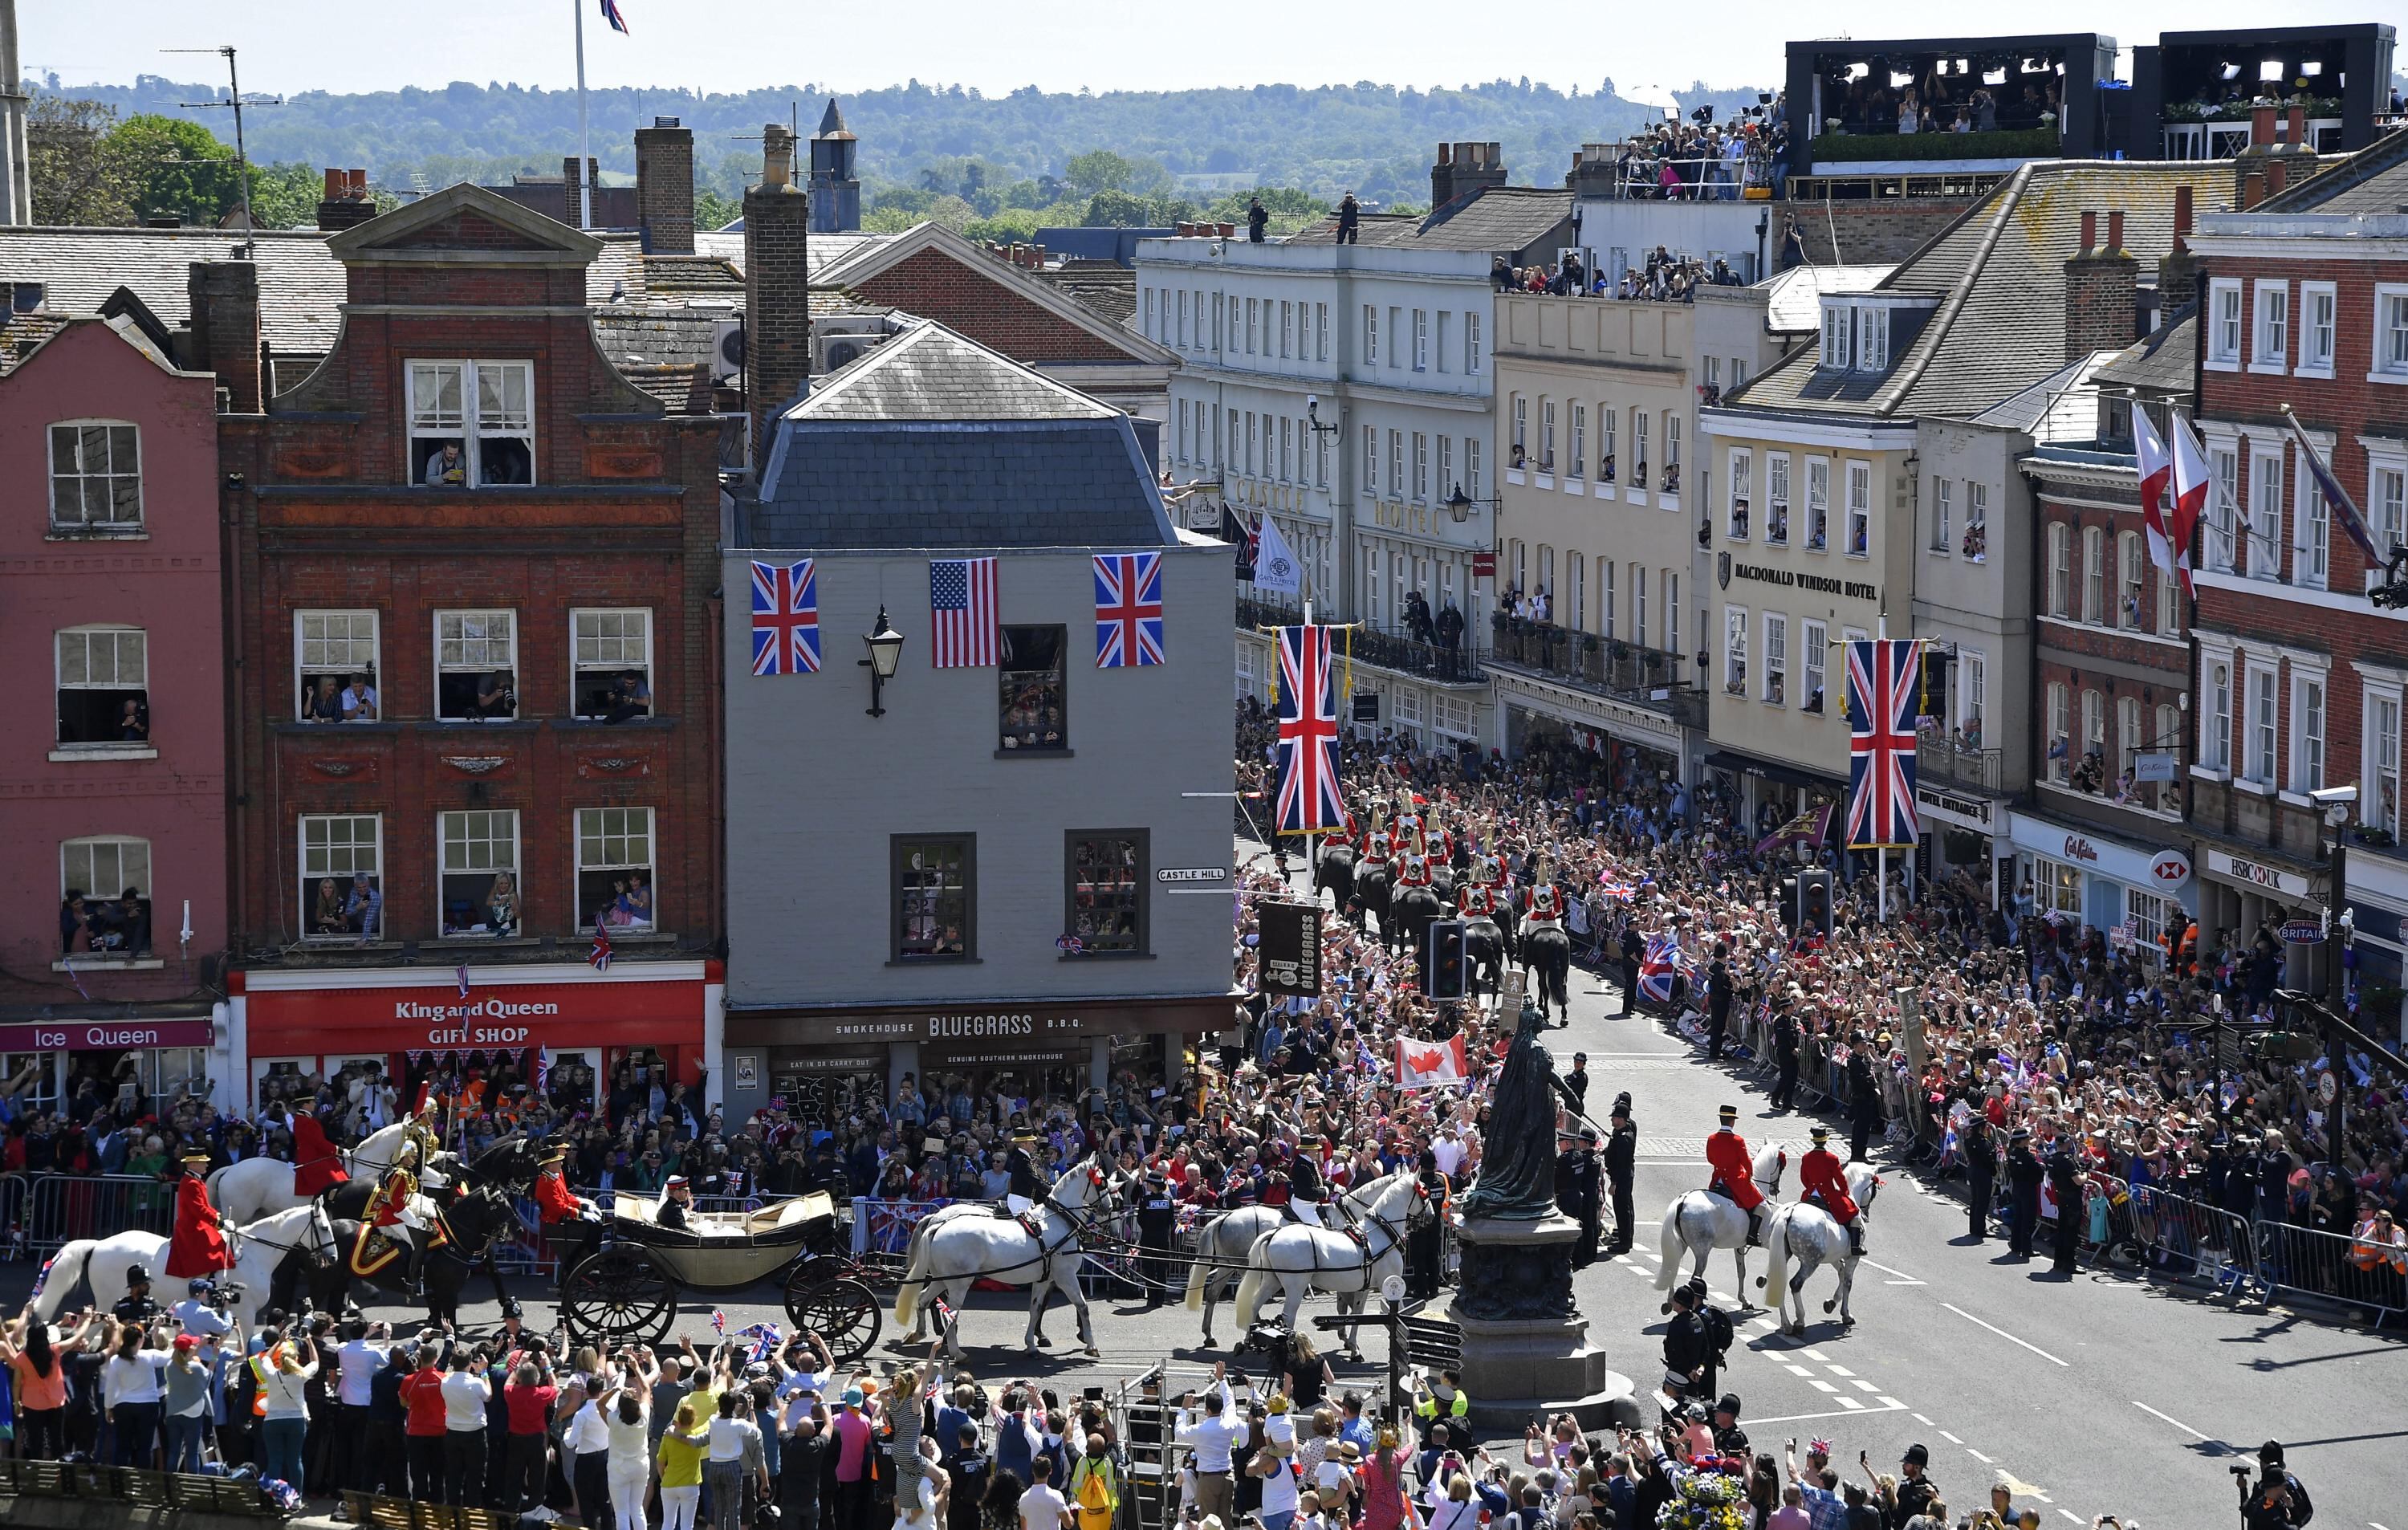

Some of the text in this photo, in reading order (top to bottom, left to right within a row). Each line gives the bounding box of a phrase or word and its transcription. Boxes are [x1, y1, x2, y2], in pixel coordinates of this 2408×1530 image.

[1236, 480, 1302, 514] CASTLE
[1375, 501, 1439, 535] HOTEL
[1735, 564, 1877, 600] MACDONALD WINDSOR HOTEL
[1919, 790, 1979, 819] HOTEL ENTRANCE
[1160, 869, 1223, 880] CASTLE HILL
[2231, 858, 2281, 889] HSBC UK
[2110, 935, 2124, 944] HARRY
[1301, 914, 1315, 990] BLUEGRASS
[396, 1000, 558, 1023] King and Queen
[35, 1027, 157, 1047] Ice Queen
[428, 1027, 529, 1044] GIFT SHOP
[836, 1015, 1084, 1037] SMOKEHOUSE BLUEGRASS B.B.Q.
[1019, 1053, 1064, 1061] SMOKEHOUSE
